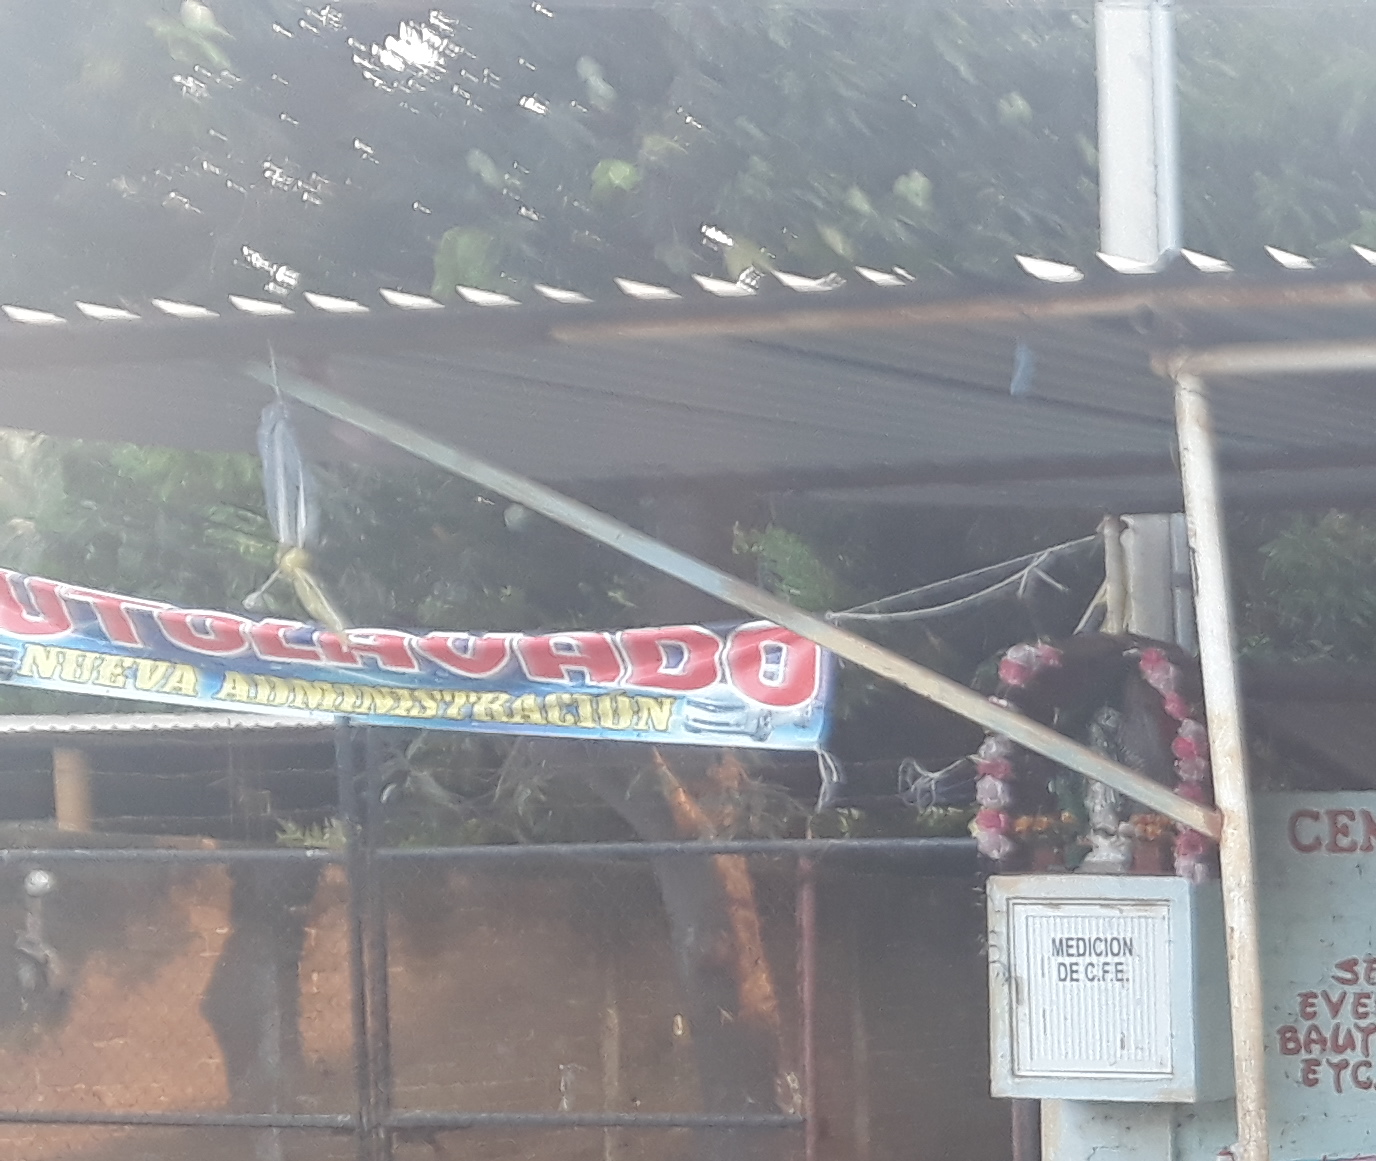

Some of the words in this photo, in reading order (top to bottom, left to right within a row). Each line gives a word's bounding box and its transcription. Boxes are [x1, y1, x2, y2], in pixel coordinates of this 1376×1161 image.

[17, 642, 200, 698] NUEVA
[1051, 936, 1134, 958] MEDICION
[1057, 961, 1080, 983] DE
[1085, 961, 1131, 983] C.F.E.
